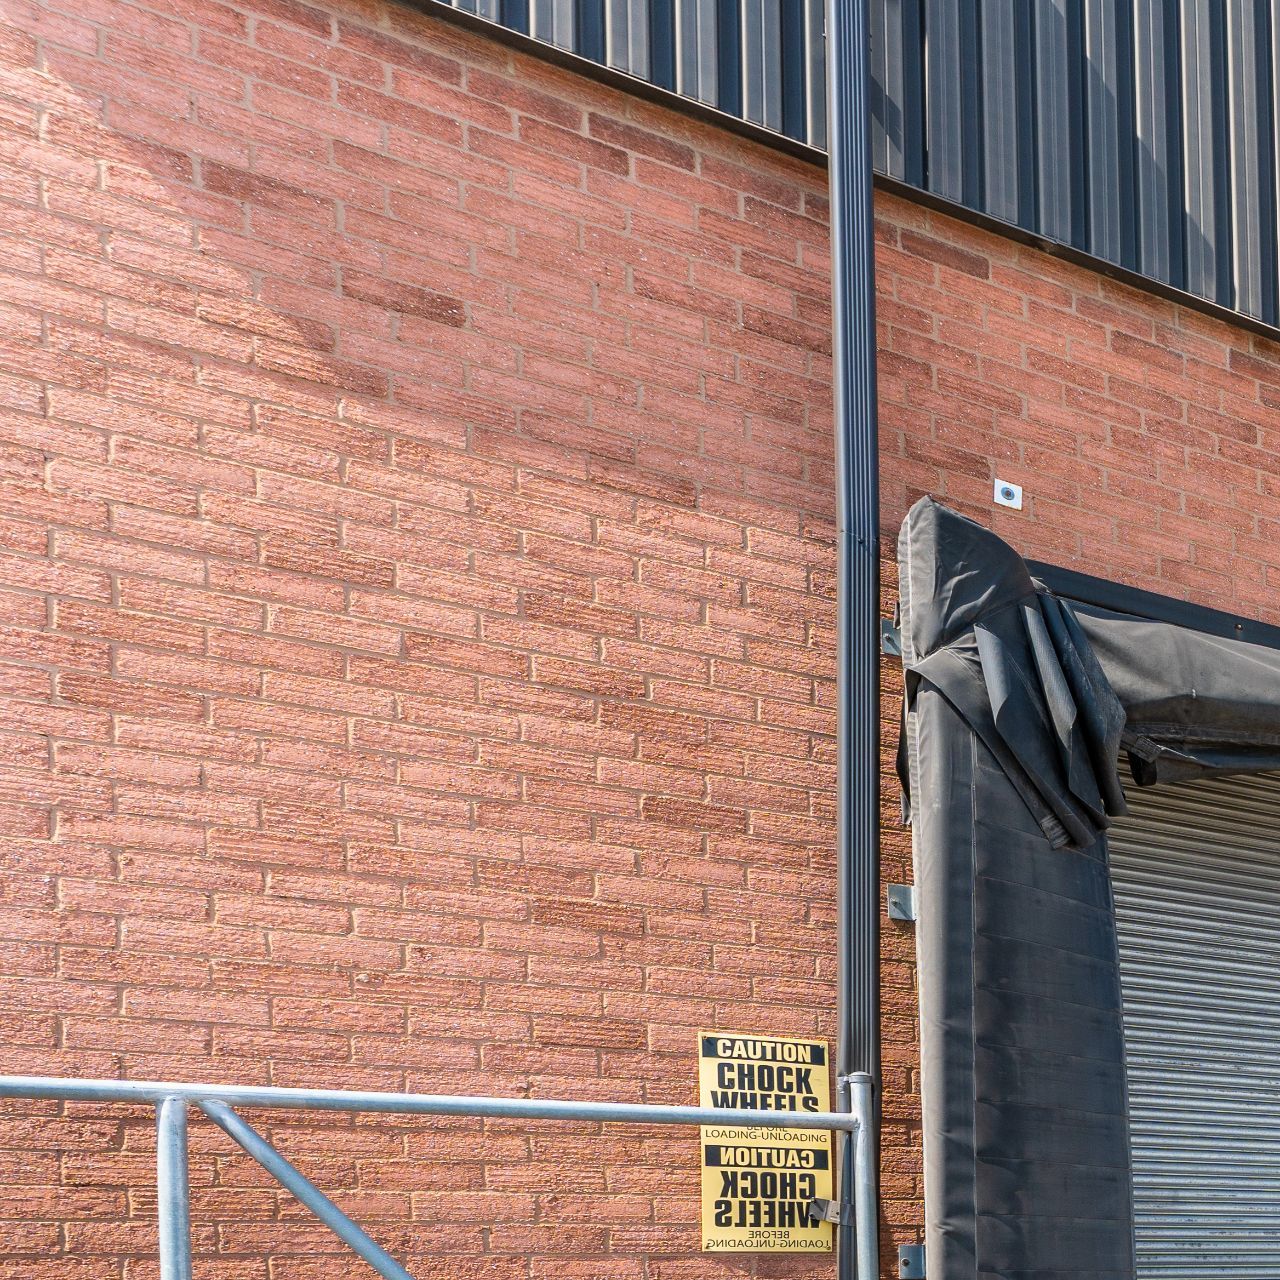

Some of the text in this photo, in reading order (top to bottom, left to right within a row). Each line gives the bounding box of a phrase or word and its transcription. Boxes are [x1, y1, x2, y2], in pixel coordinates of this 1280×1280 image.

[717, 1039, 811, 1062] CAUTION
[717, 1063, 812, 1094] CHOCK
[705, 1129, 827, 1143] LOADING-UNLOADING
